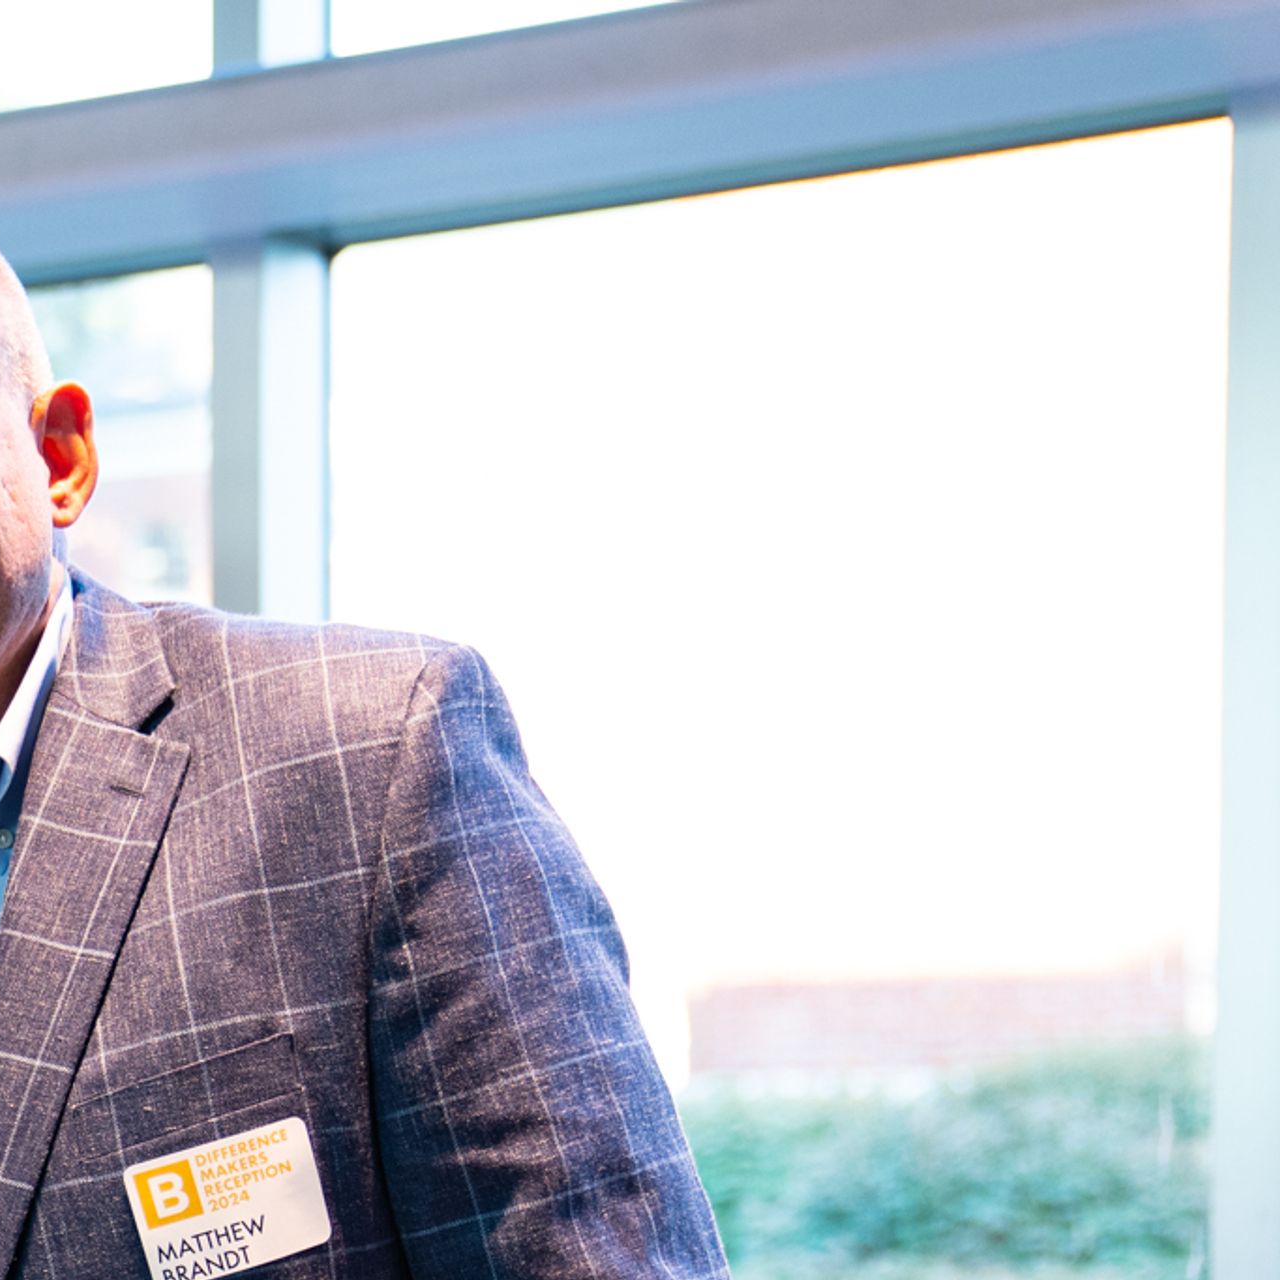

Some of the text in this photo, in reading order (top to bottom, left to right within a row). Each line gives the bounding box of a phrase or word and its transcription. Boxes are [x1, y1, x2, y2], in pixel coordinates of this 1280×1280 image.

[195, 1129, 288, 1168] DIFFERENCE
[200, 1152, 269, 1183] MAKERS
[204, 1161, 293, 1197] RECEPTION
[147, 1171, 190, 1220] B
[208, 1190, 251, 1212] 2024
[157, 1214, 266, 1264] MATTHEW
